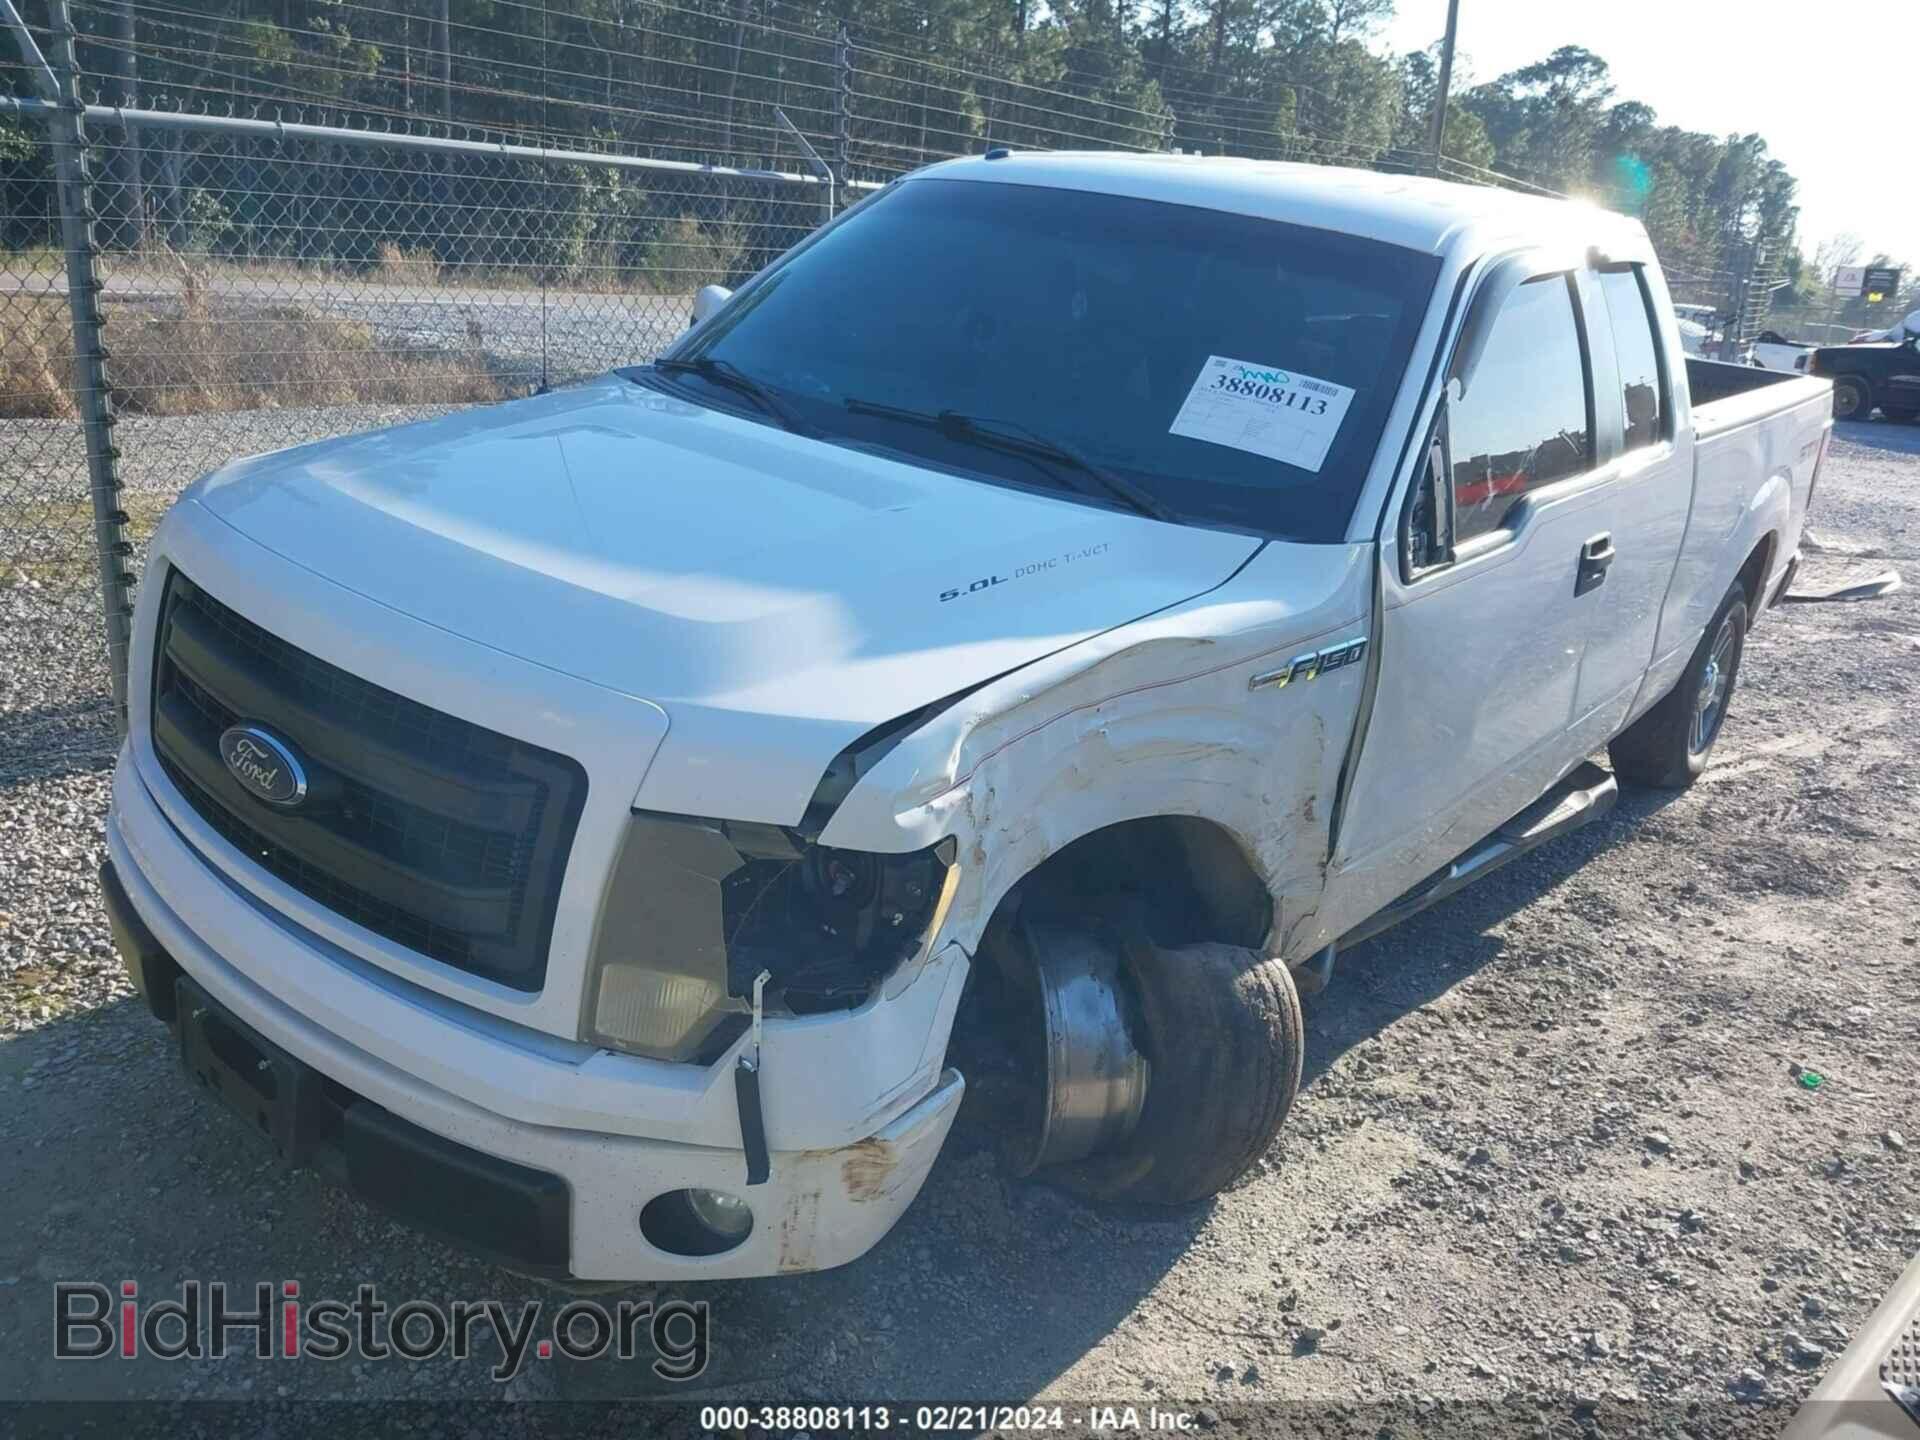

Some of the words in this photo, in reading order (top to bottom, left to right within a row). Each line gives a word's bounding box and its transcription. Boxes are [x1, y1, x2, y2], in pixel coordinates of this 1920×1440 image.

[1210, 374, 1328, 416] 38808113
[939, 575, 1009, 602] 5.0L
[1015, 558, 1057, 578] DOHC
[230, 739, 279, 790] Ford
